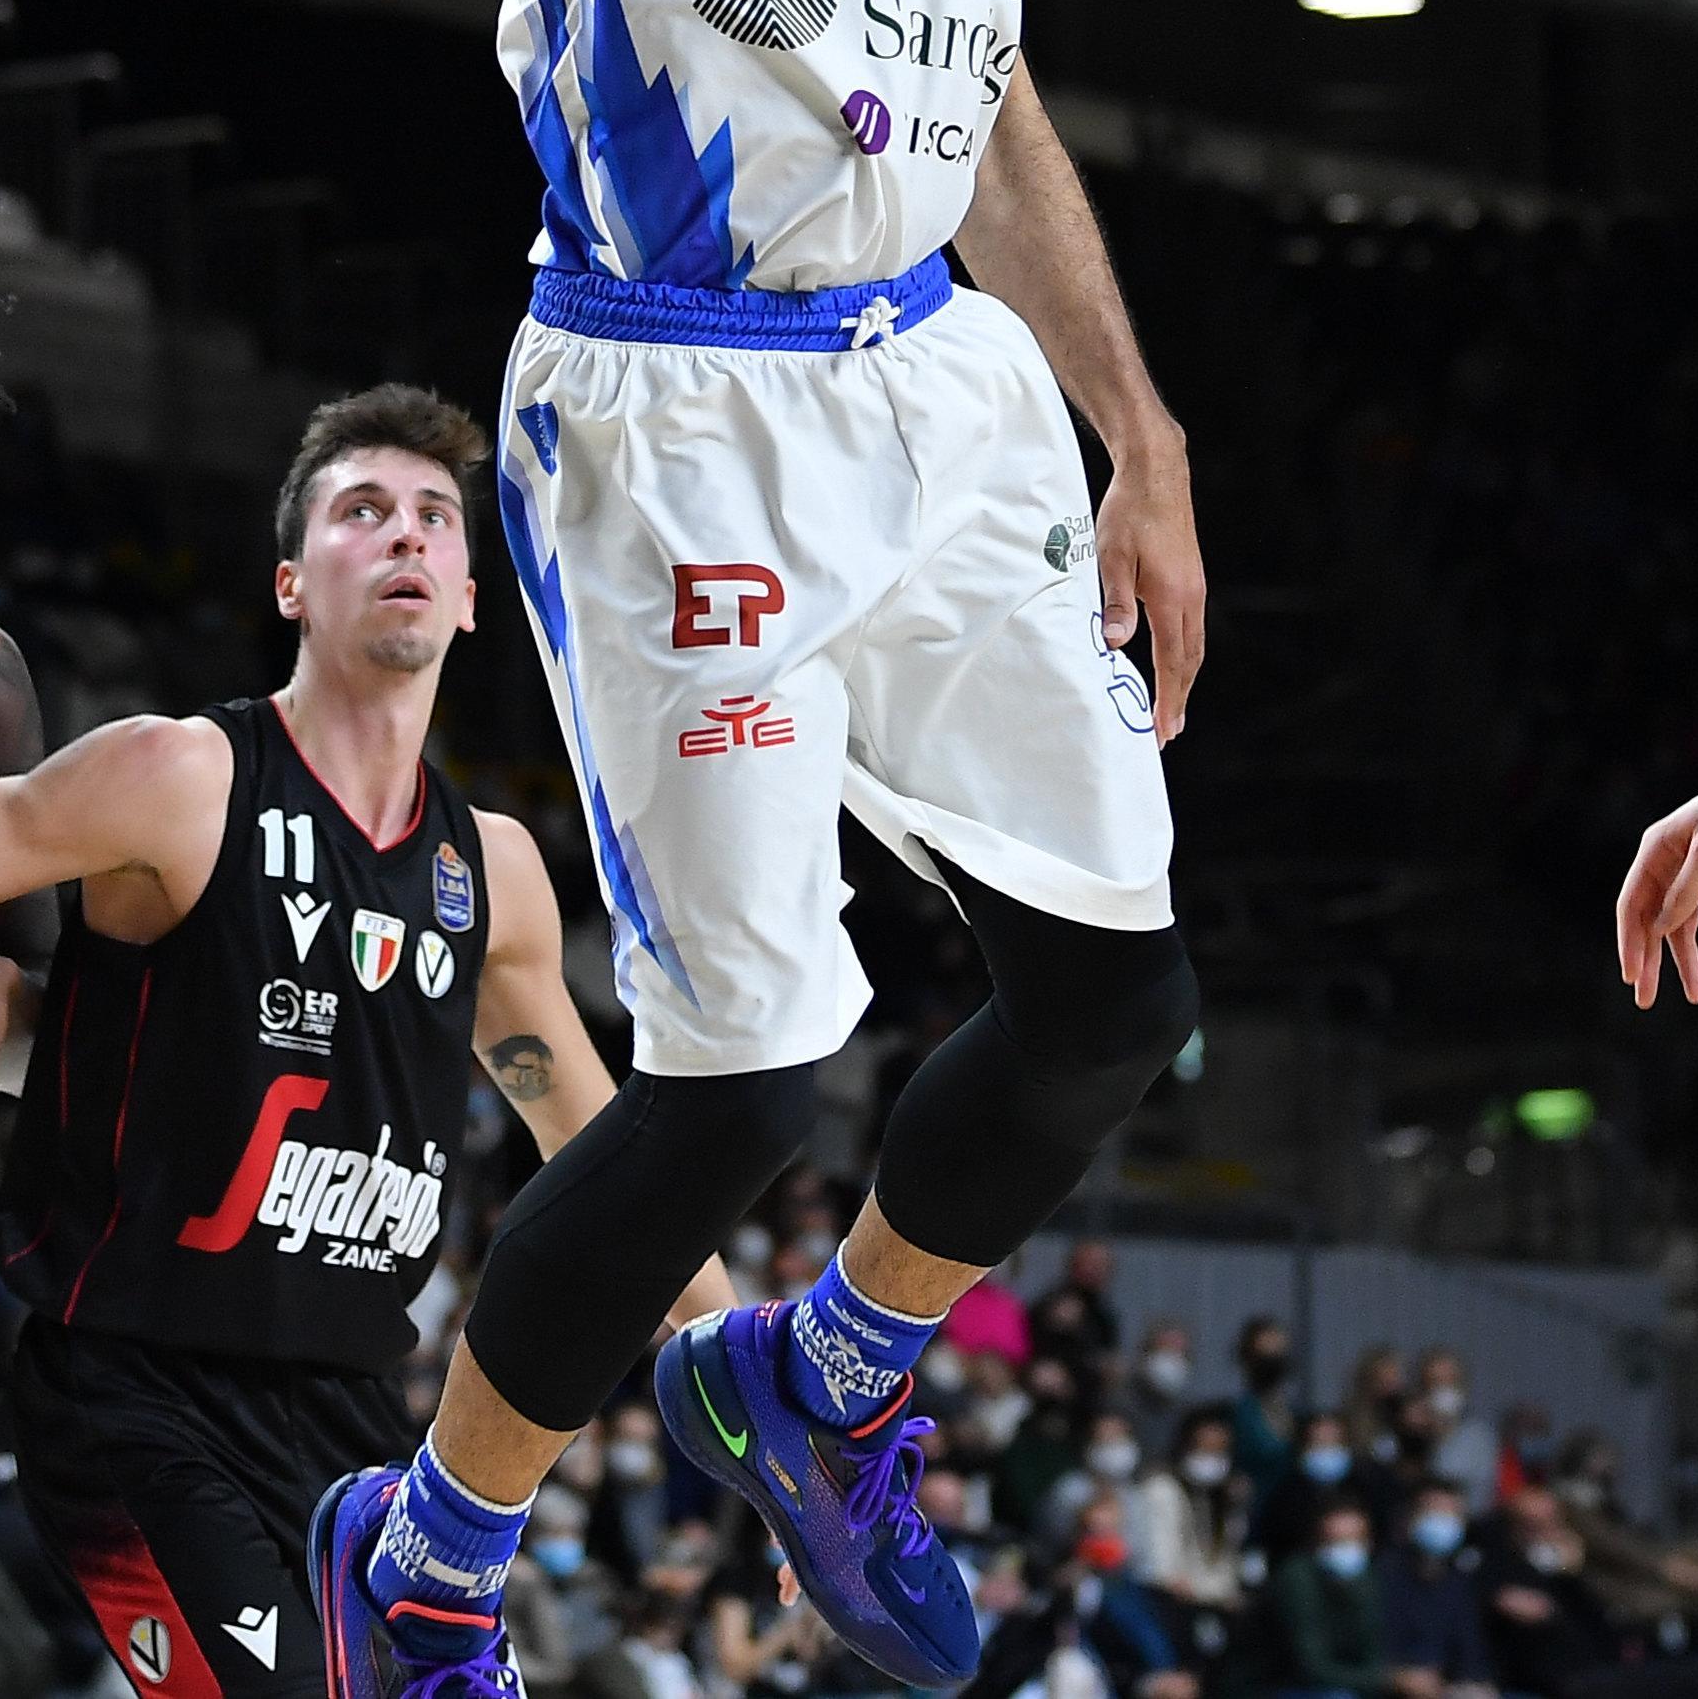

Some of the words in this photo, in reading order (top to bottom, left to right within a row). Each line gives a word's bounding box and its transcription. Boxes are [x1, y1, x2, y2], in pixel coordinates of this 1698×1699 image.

[258, 807, 315, 884] 11
[303, 989, 339, 1017] ER
[321, 1241, 397, 1274] ZANE
